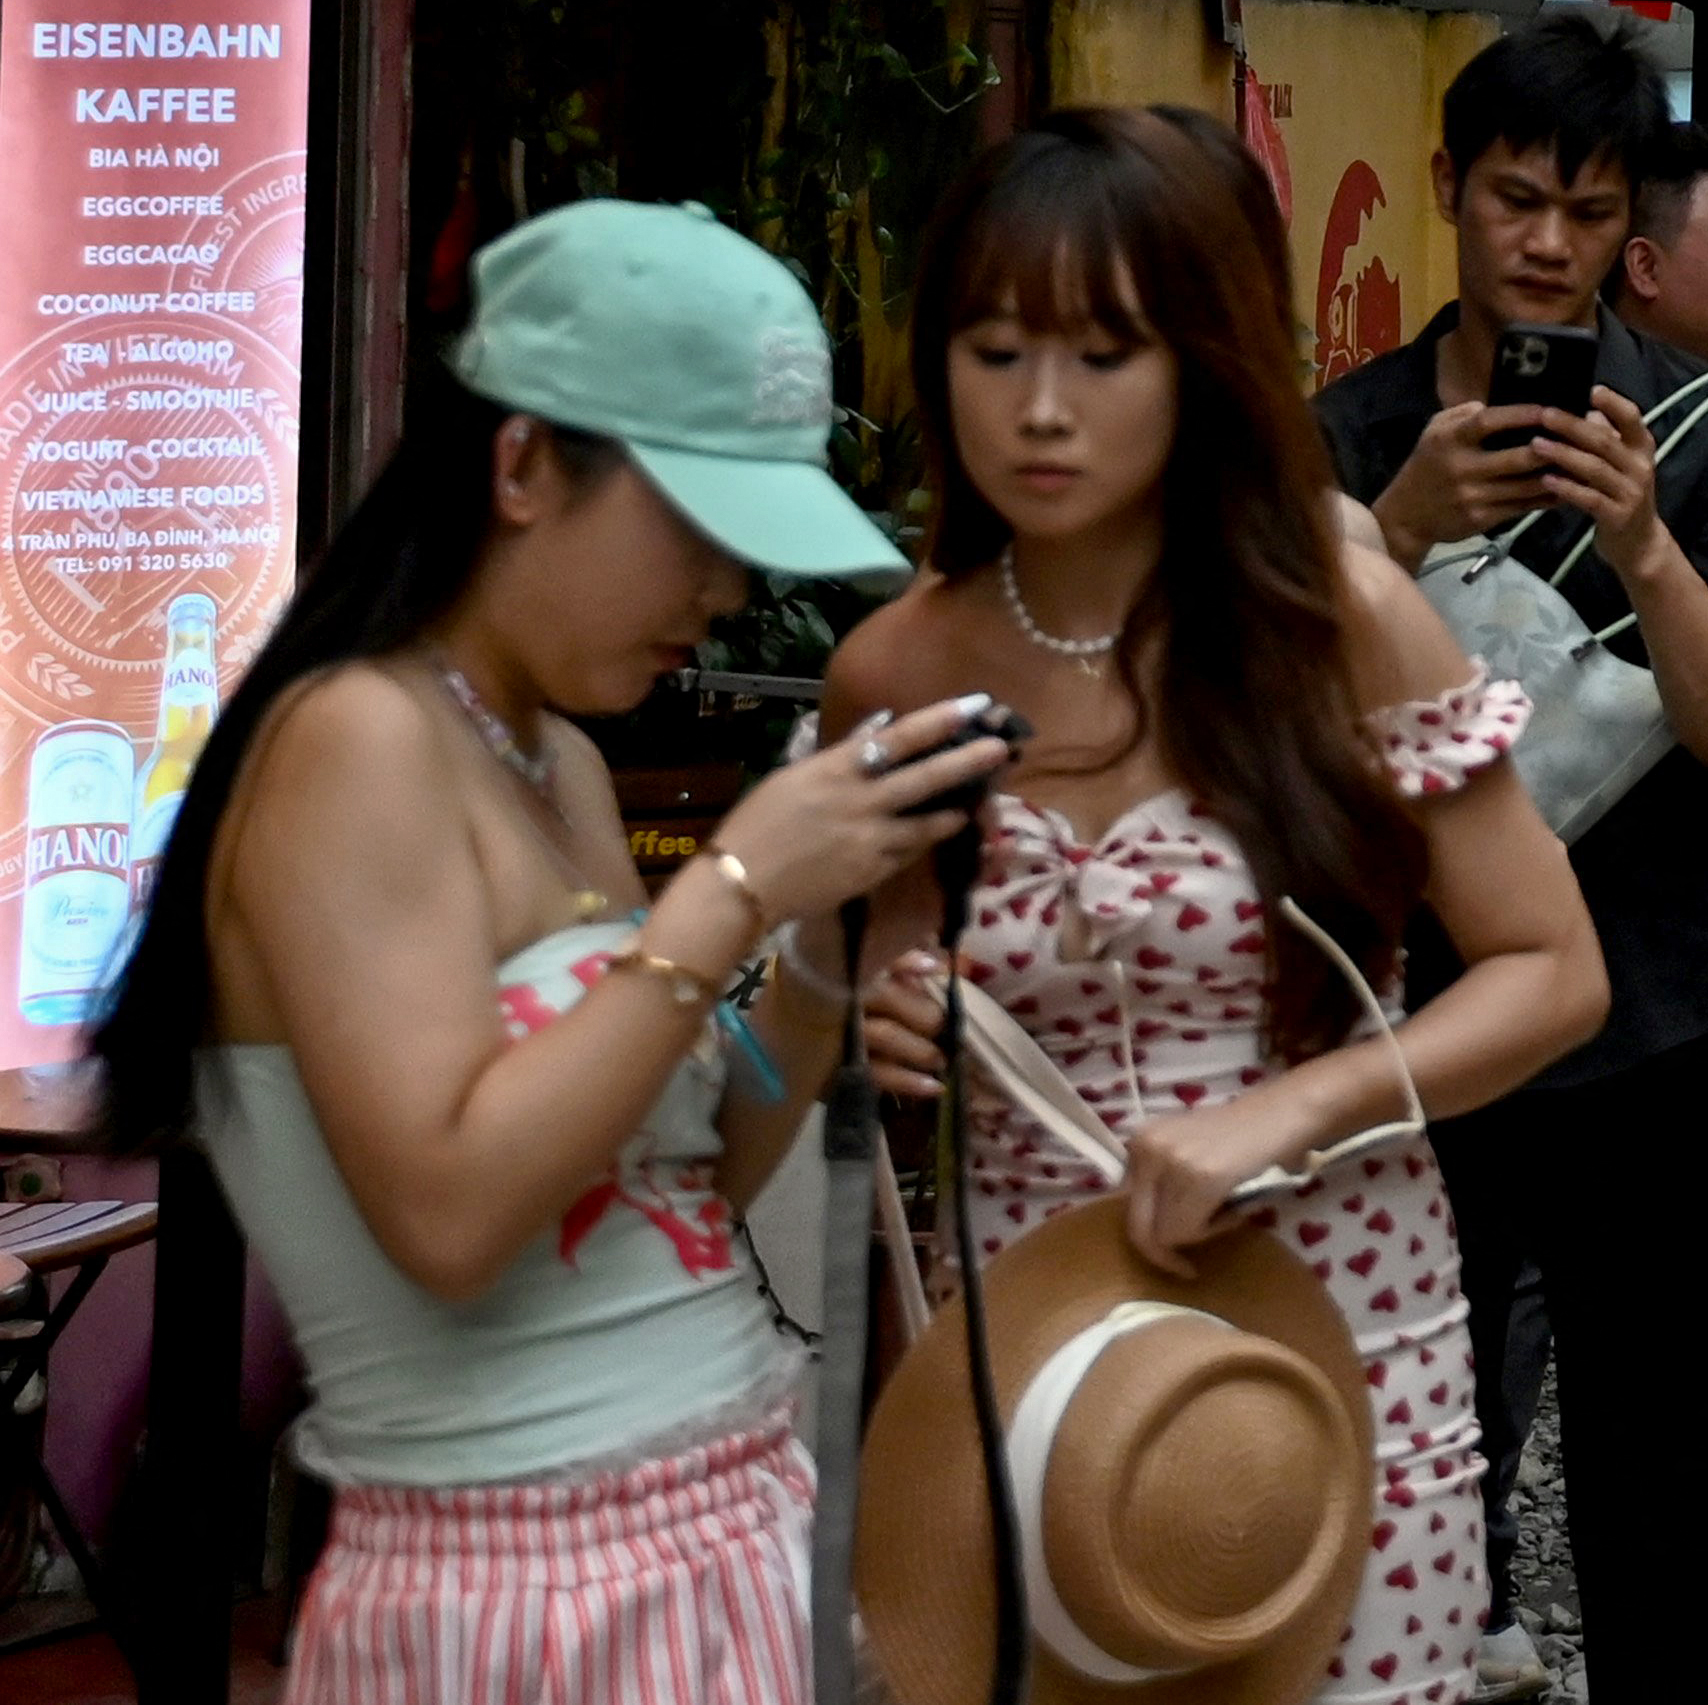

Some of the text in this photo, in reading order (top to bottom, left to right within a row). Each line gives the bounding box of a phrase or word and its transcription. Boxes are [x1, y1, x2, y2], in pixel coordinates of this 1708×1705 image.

[33, 22, 281, 59] EISENBAHN
[76, 88, 236, 123] KAFFEE
[89, 143, 220, 172] BIA HÀ NỘI
[83, 196, 224, 218] EGGCOFFEE
[84, 244, 220, 266] EGGCACAO
[38, 291, 256, 315] COCONUT COFFEE
[62, 343, 106, 363] TEA
[36, 390, 107, 413] JUICE
[126, 388, 255, 410] SMOOTHIE
[27, 436, 264, 462] YOGURT COCKTAIL
[20, 484, 265, 511] VIETNAMESE FOODS
[125, 531, 150, 548] BA
[55, 552, 228, 574] TEL: 091 320 5630
